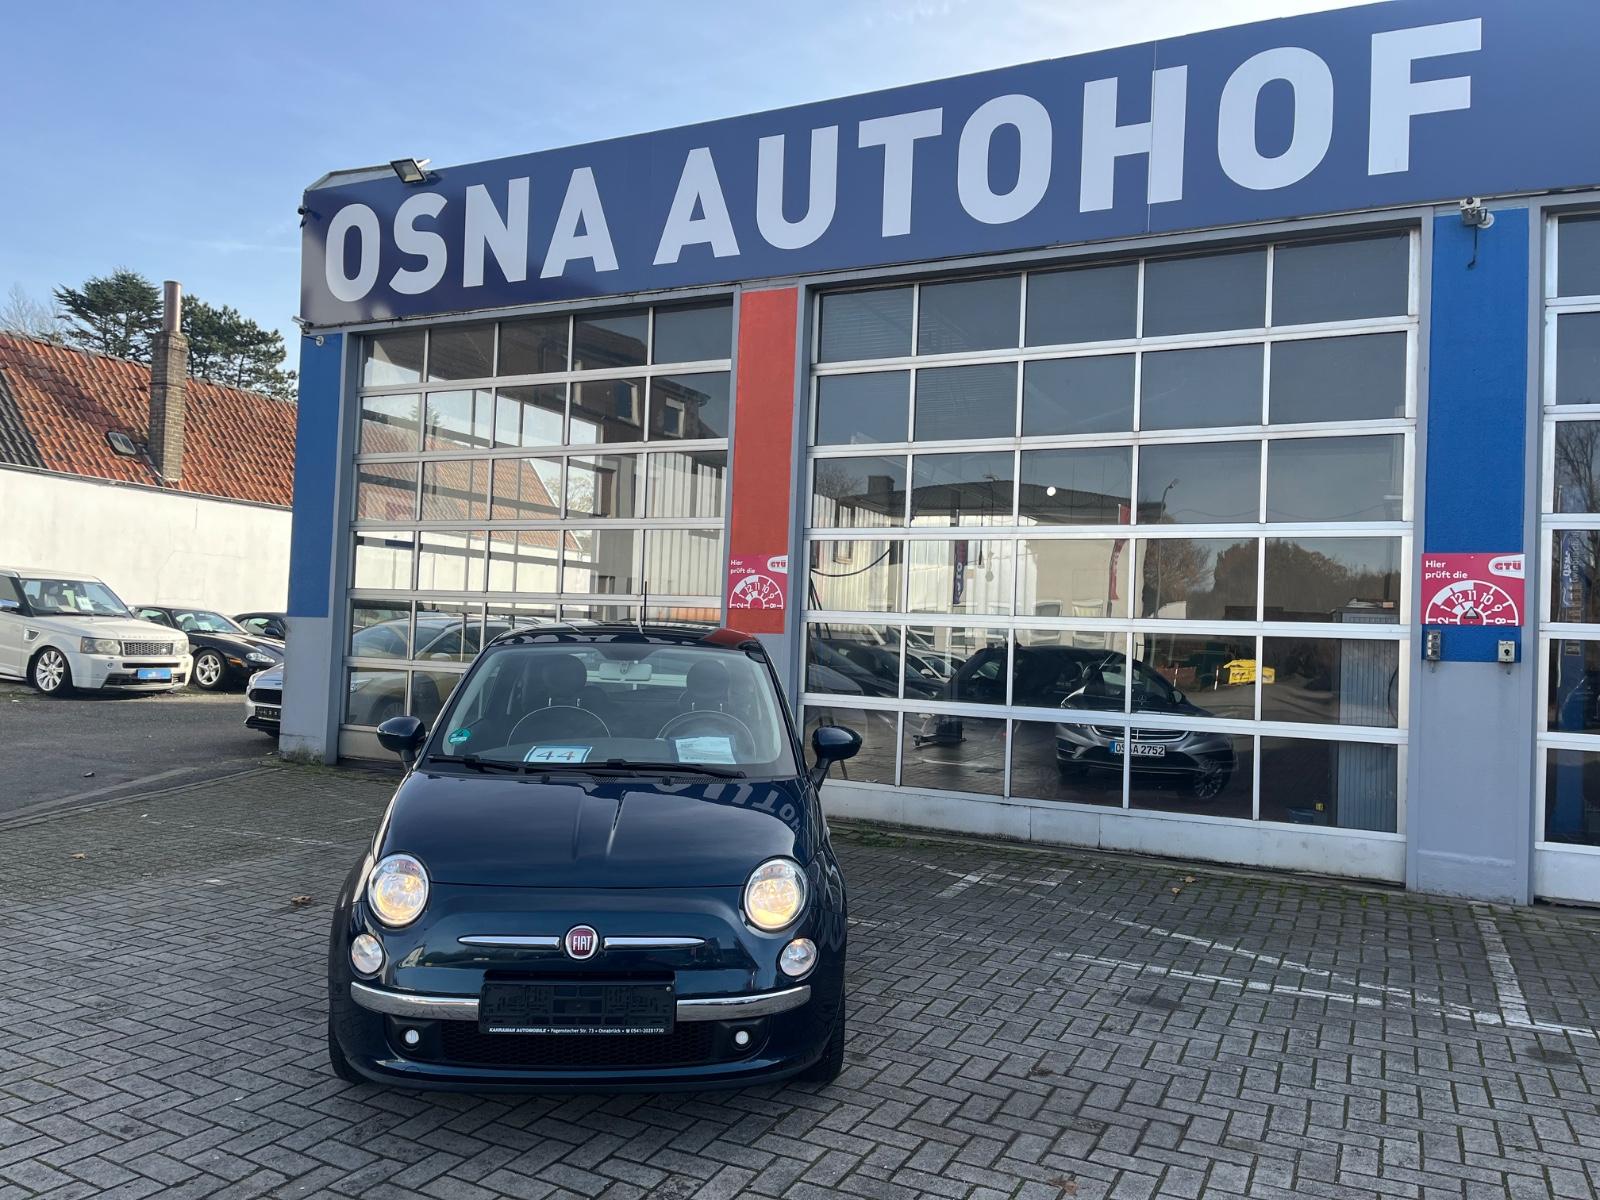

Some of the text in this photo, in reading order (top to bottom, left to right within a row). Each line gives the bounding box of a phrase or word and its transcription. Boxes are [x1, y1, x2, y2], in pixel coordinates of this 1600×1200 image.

[324, 18, 1482, 302] OSNA AUTOHOF
[1425, 560, 1447, 569] Hier
[1494, 560, 1522, 571] GTÜ
[1425, 571, 1468, 580] prüft die
[1450, 590, 1494, 606] 12 11 10
[536, 751, 575, 761] 44
[1140, 745, 1165, 756] 2752
[572, 935, 592, 951] FIAT
